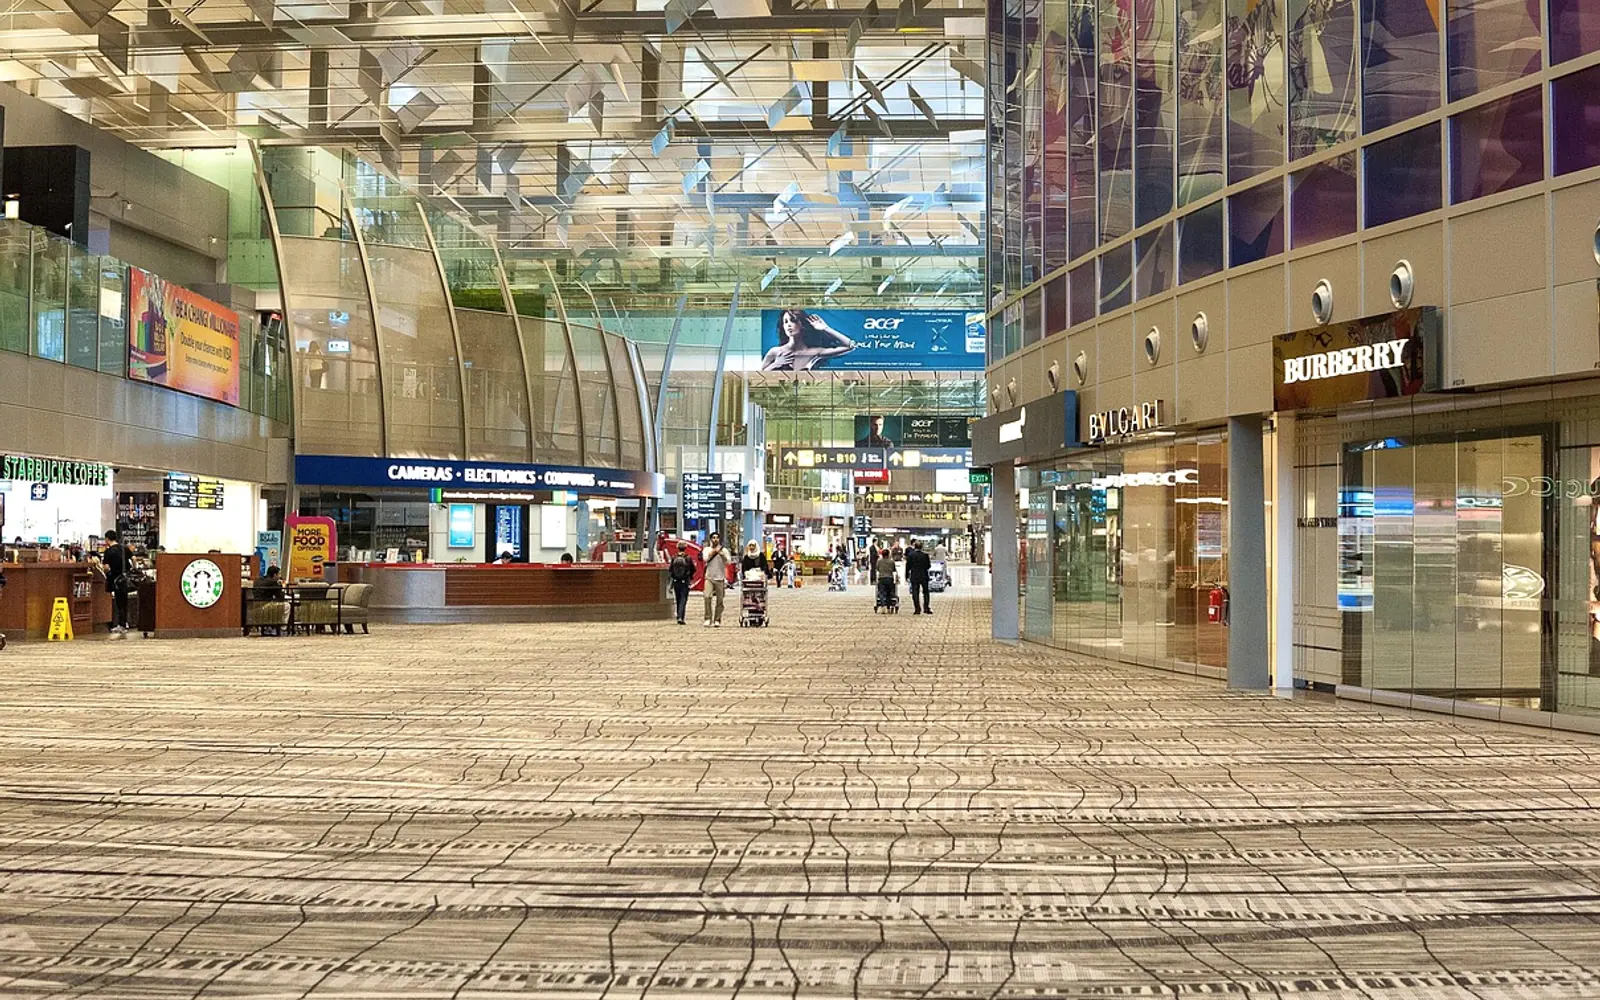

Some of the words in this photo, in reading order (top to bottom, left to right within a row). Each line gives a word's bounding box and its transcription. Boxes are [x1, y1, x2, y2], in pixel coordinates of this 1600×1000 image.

[863, 317, 905, 330] acer
[1283, 338, 1409, 384] BURBERRY
[911, 419, 934, 427] acer
[1089, 399, 1164, 440] BVLGARI
[815, 453, 828, 463] B1
[836, 453, 857, 463] B10
[3, 455, 72, 483] STARBUCKS
[74, 463, 109, 486] COFFEE
[387, 464, 454, 481] CAMERAS
[464, 468, 537, 485] ELECTRONICS
[971, 474, 985, 483] EXIT
[297, 528, 322, 536] MORE
[293, 536, 326, 546] FOOD
